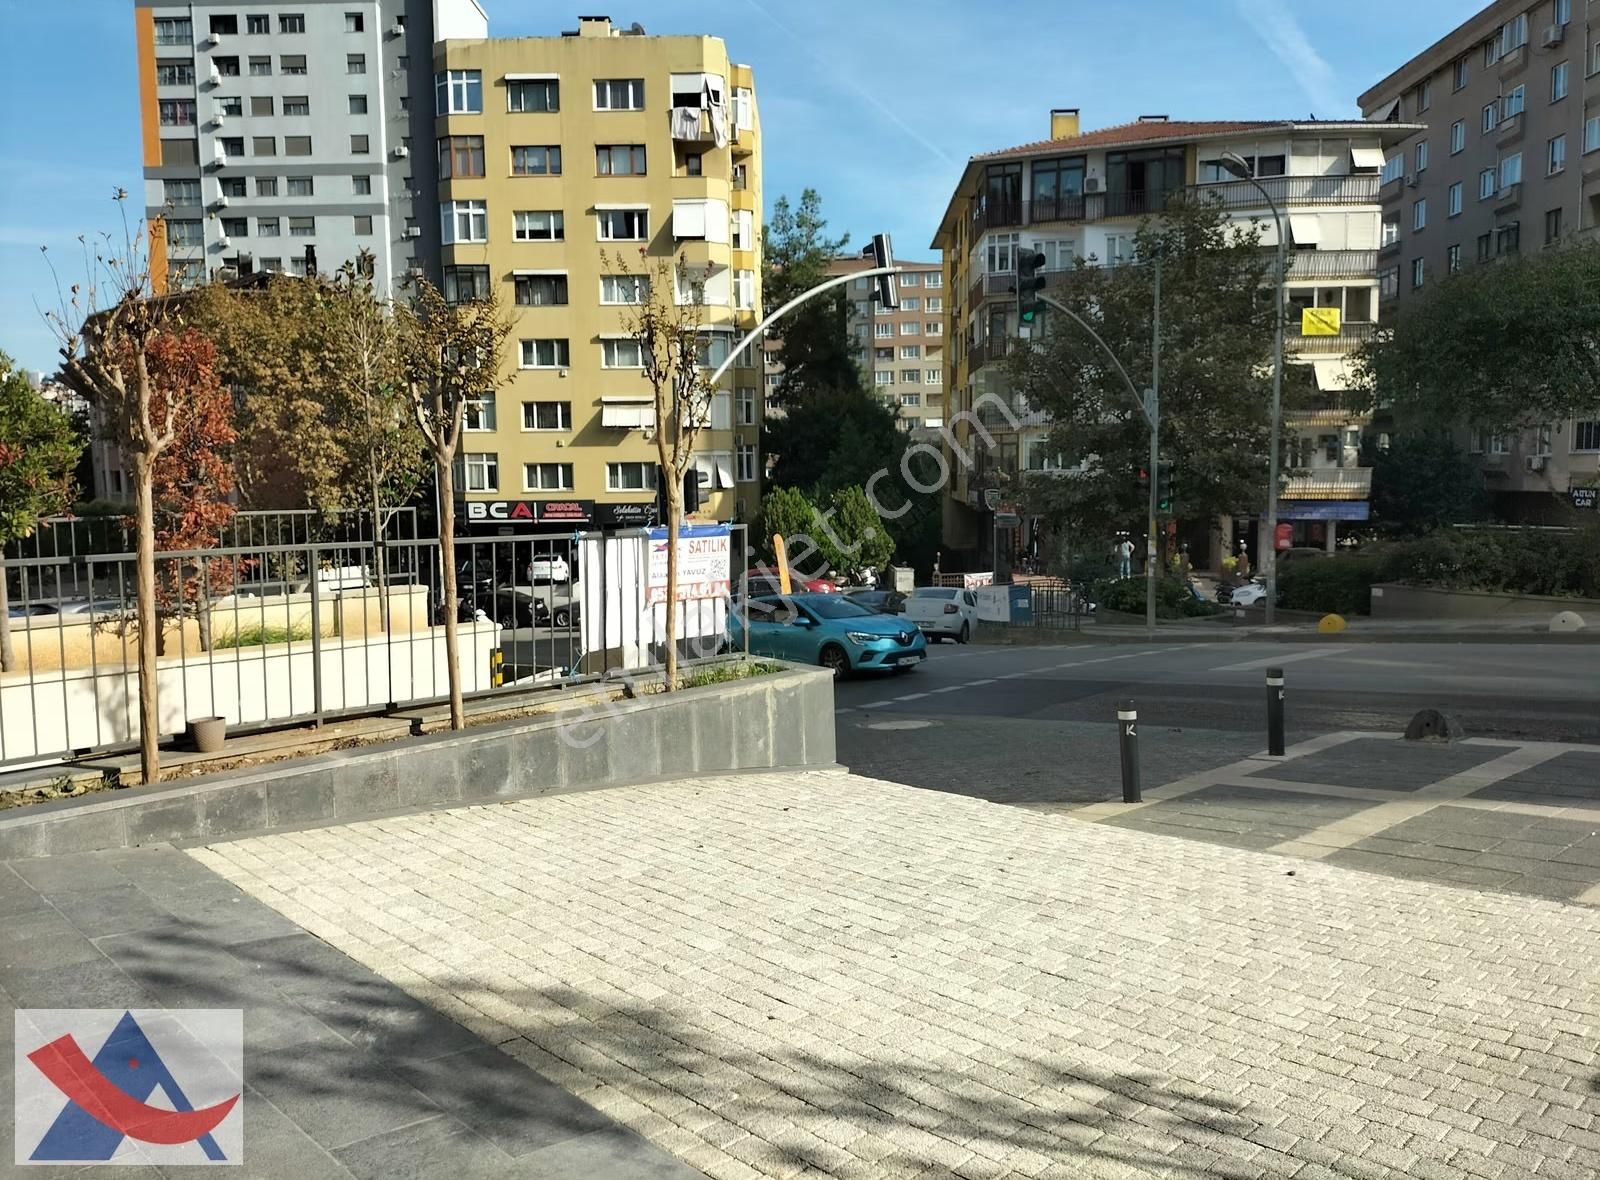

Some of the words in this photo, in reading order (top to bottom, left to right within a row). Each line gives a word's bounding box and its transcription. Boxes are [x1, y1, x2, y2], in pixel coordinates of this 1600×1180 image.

[1575, 498, 1592, 507] CAR
[467, 502, 533, 518] BCA
[682, 568, 707, 576] YAVUZ
